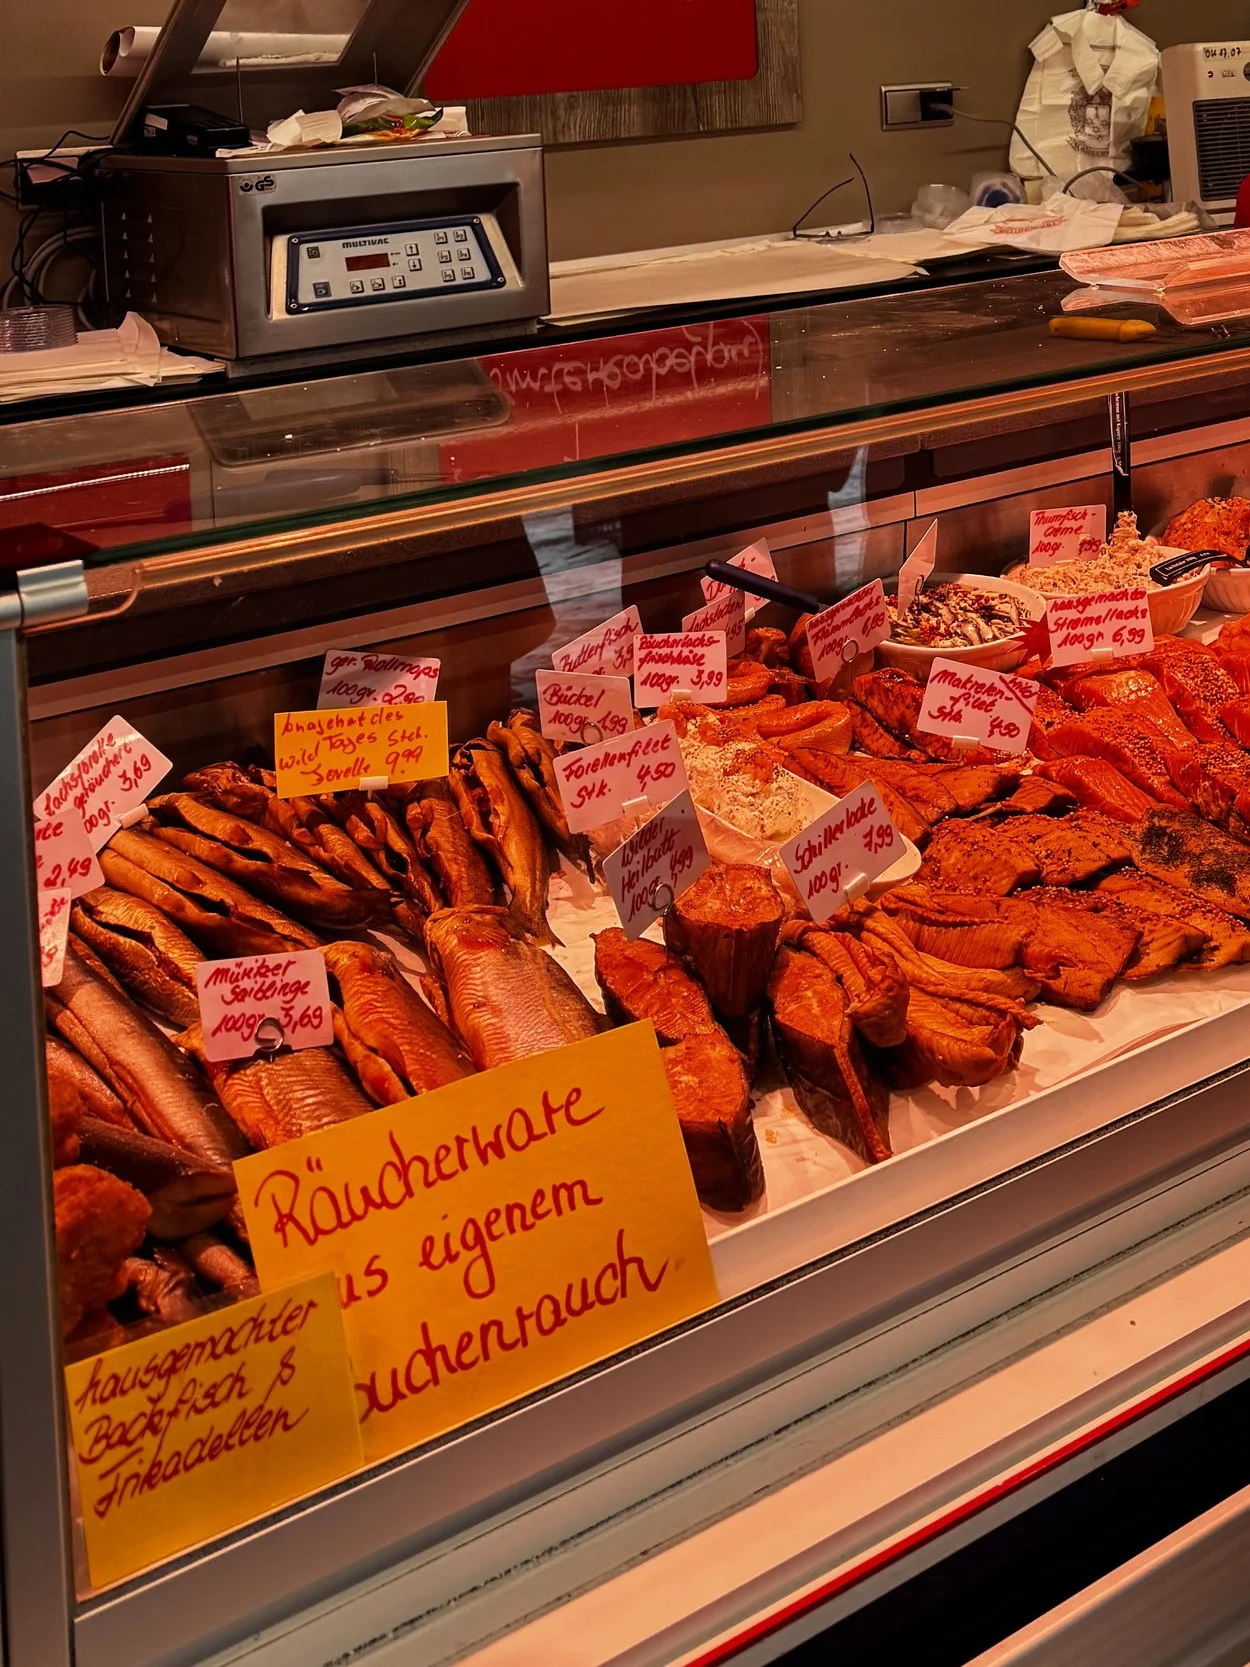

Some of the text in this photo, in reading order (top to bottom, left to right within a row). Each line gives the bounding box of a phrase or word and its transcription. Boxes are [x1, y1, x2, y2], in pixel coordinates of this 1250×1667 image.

[1050, 588, 1147, 615] hausgemachter
[361, 653, 440, 681] Rollmops
[690, 669, 724, 691] 3,99
[118, 753, 153, 792] 3,69
[562, 734, 673, 783] Forellenfilet
[570, 761, 676, 809] Stk. 4,50
[794, 797, 878, 874] Schillerlocke
[863, 824, 895, 854] 7,99
[280, 1005, 324, 1035] 3,69
[254, 1087, 606, 1248] Räucherware
[418, 1177, 604, 1301] eigenem
[74, 1297, 319, 1415] hausgemachter
[78, 1360, 253, 1466] Backfisch
[93, 1406, 310, 1519] Frikadellen
